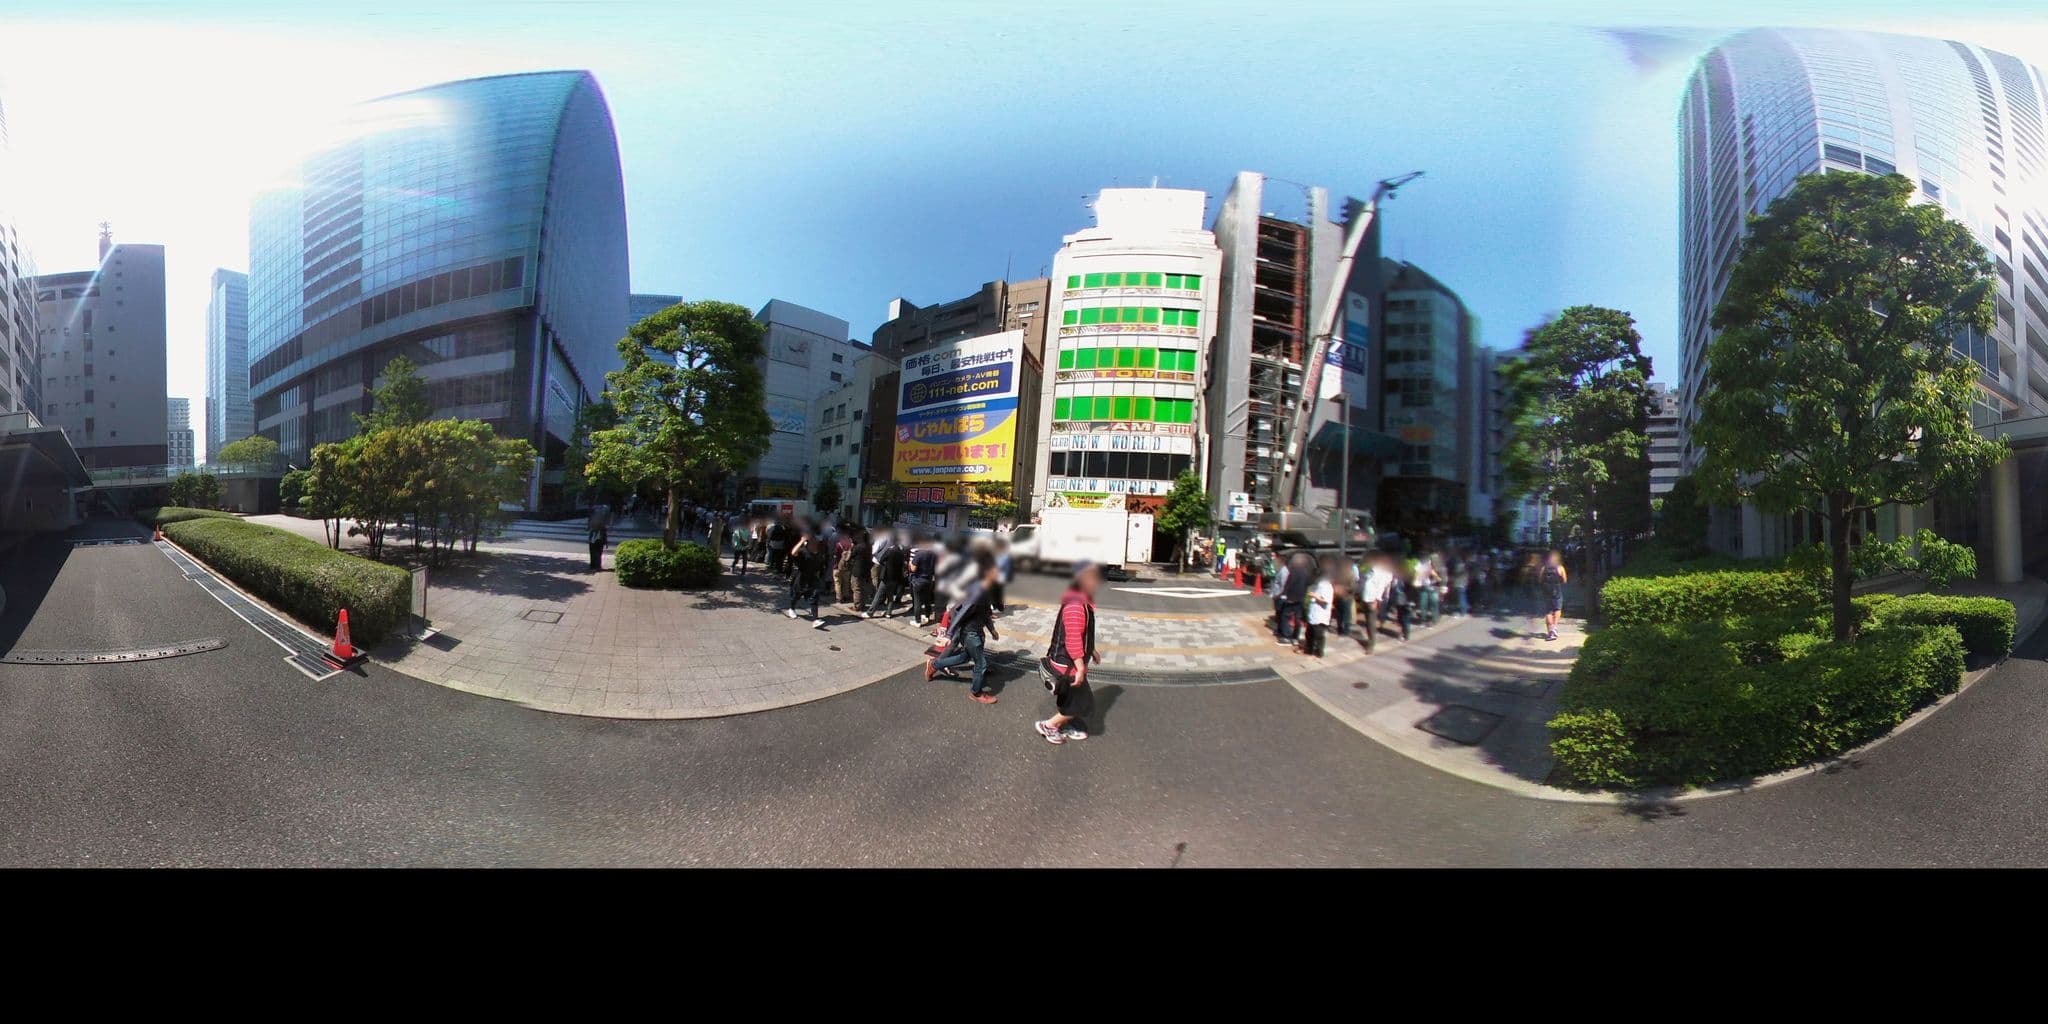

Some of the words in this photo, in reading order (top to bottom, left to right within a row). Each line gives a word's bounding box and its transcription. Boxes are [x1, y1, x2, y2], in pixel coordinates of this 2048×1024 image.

[928, 379, 999, 399] 111-net.com
[1071, 434, 1100, 450] NEW
[912, 464, 985, 476] www.janpara.co.jp
